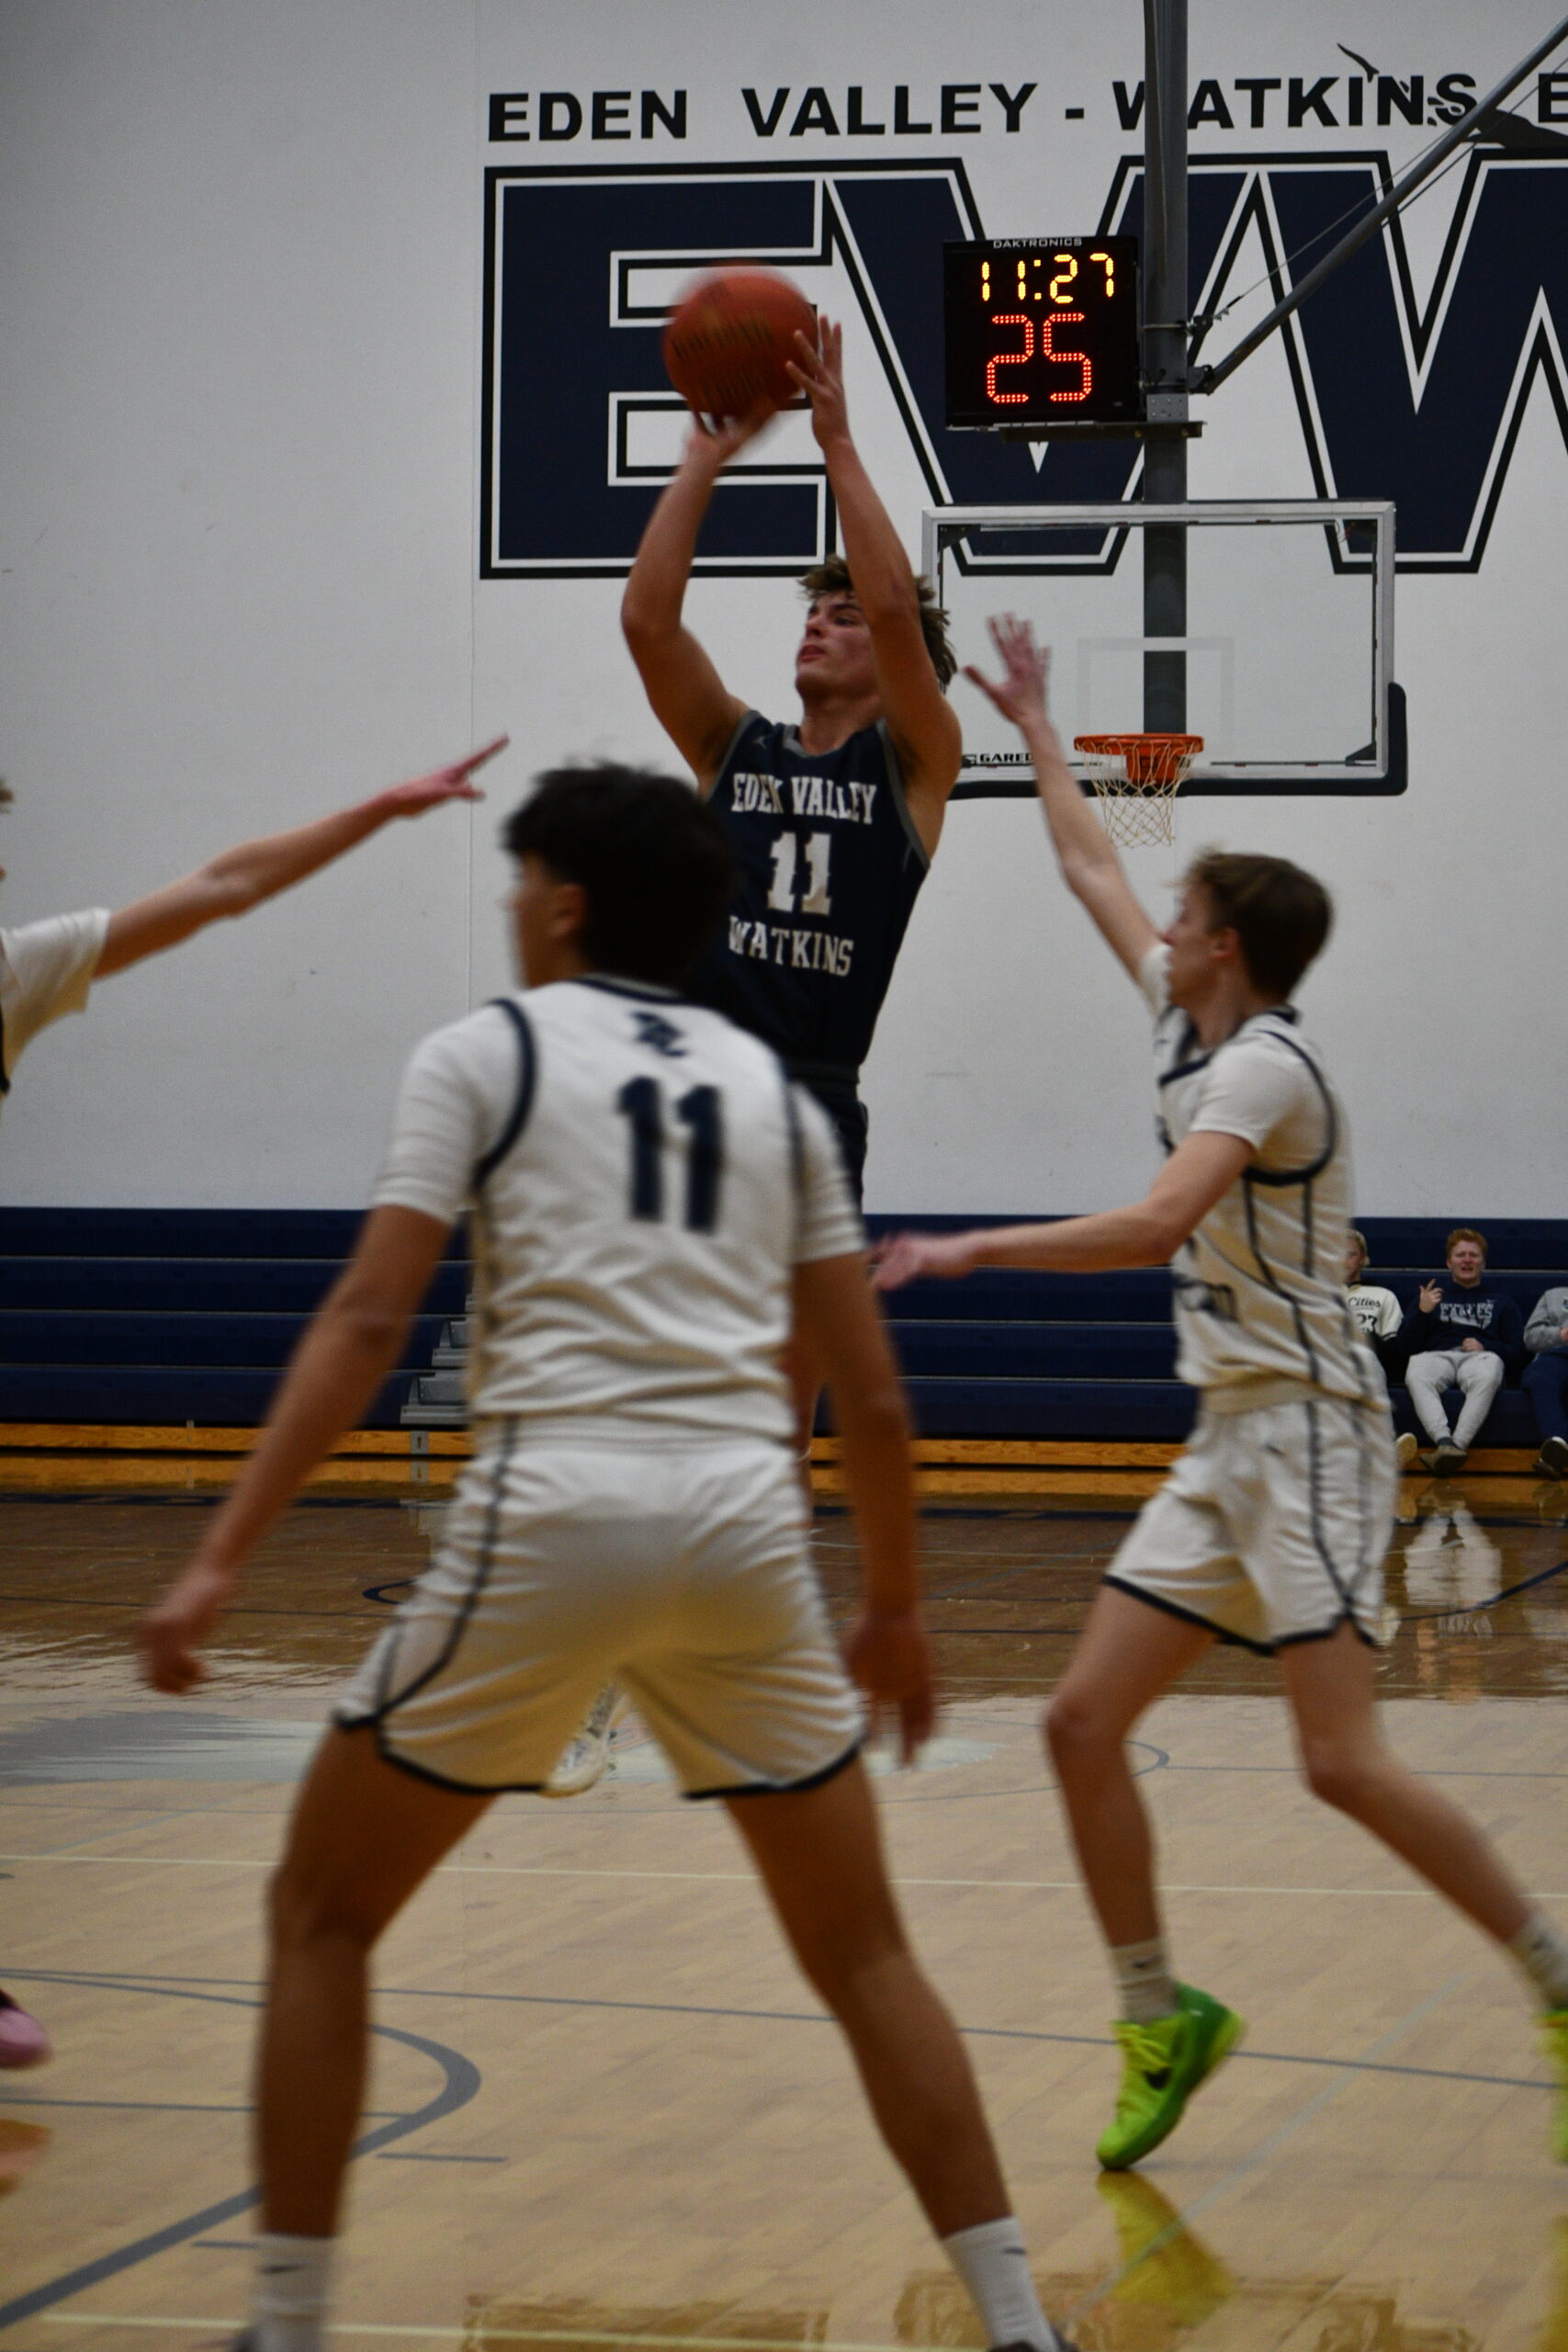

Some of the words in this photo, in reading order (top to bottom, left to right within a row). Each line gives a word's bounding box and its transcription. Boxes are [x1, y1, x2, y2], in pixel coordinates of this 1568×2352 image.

[489, 90, 687, 141] EDEN
[741, 84, 1038, 137] VALLEY
[993, 237, 1082, 249] DAKTRONICS
[981, 253, 1114, 304] 11:27
[987, 312, 1092, 403] 25
[731, 773, 784, 814] EDEN
[791, 775, 877, 824] VALLEY
[767, 831, 831, 916] 11
[728, 915, 854, 977] WATKINS
[617, 1074, 724, 1235] 11
